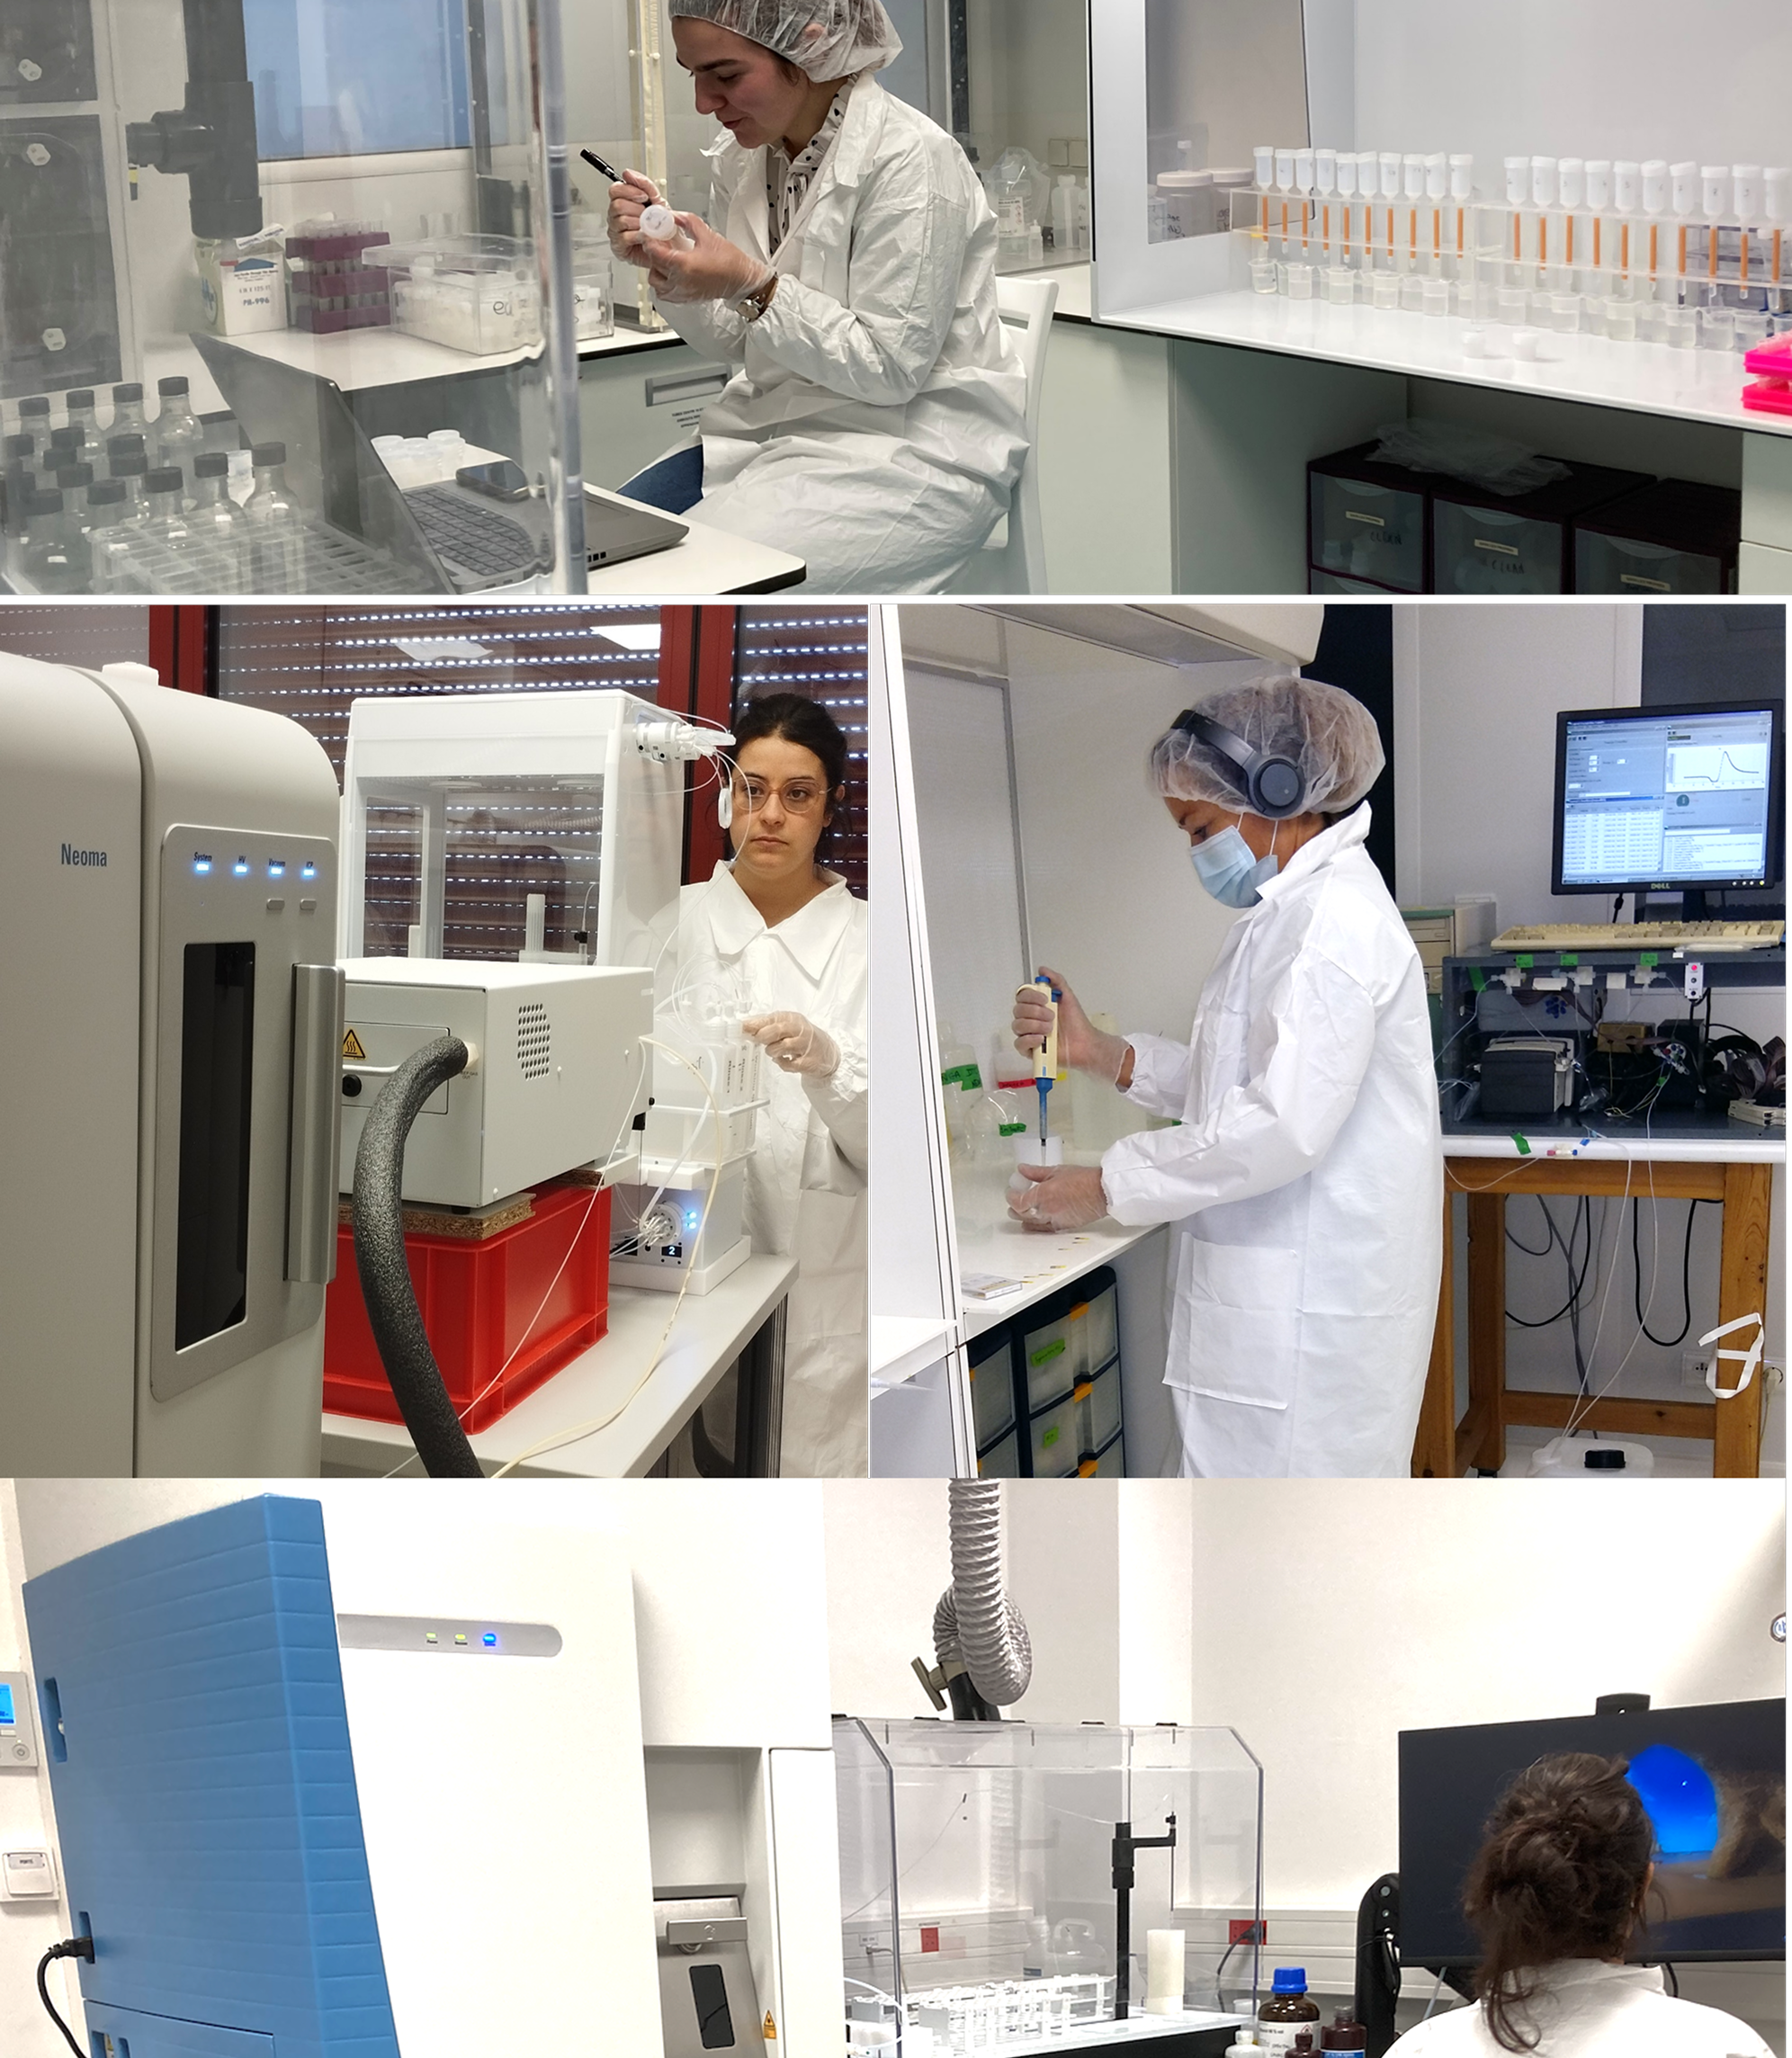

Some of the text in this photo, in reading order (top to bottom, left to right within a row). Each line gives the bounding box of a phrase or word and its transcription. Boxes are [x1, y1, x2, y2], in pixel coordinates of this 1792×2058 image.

[61, 843, 107, 867] Neoma
[193, 851, 212, 863] System
[238, 855, 246, 863] HV
[269, 857, 286, 867] Vacuum
[668, 1246, 676, 1256] 2
